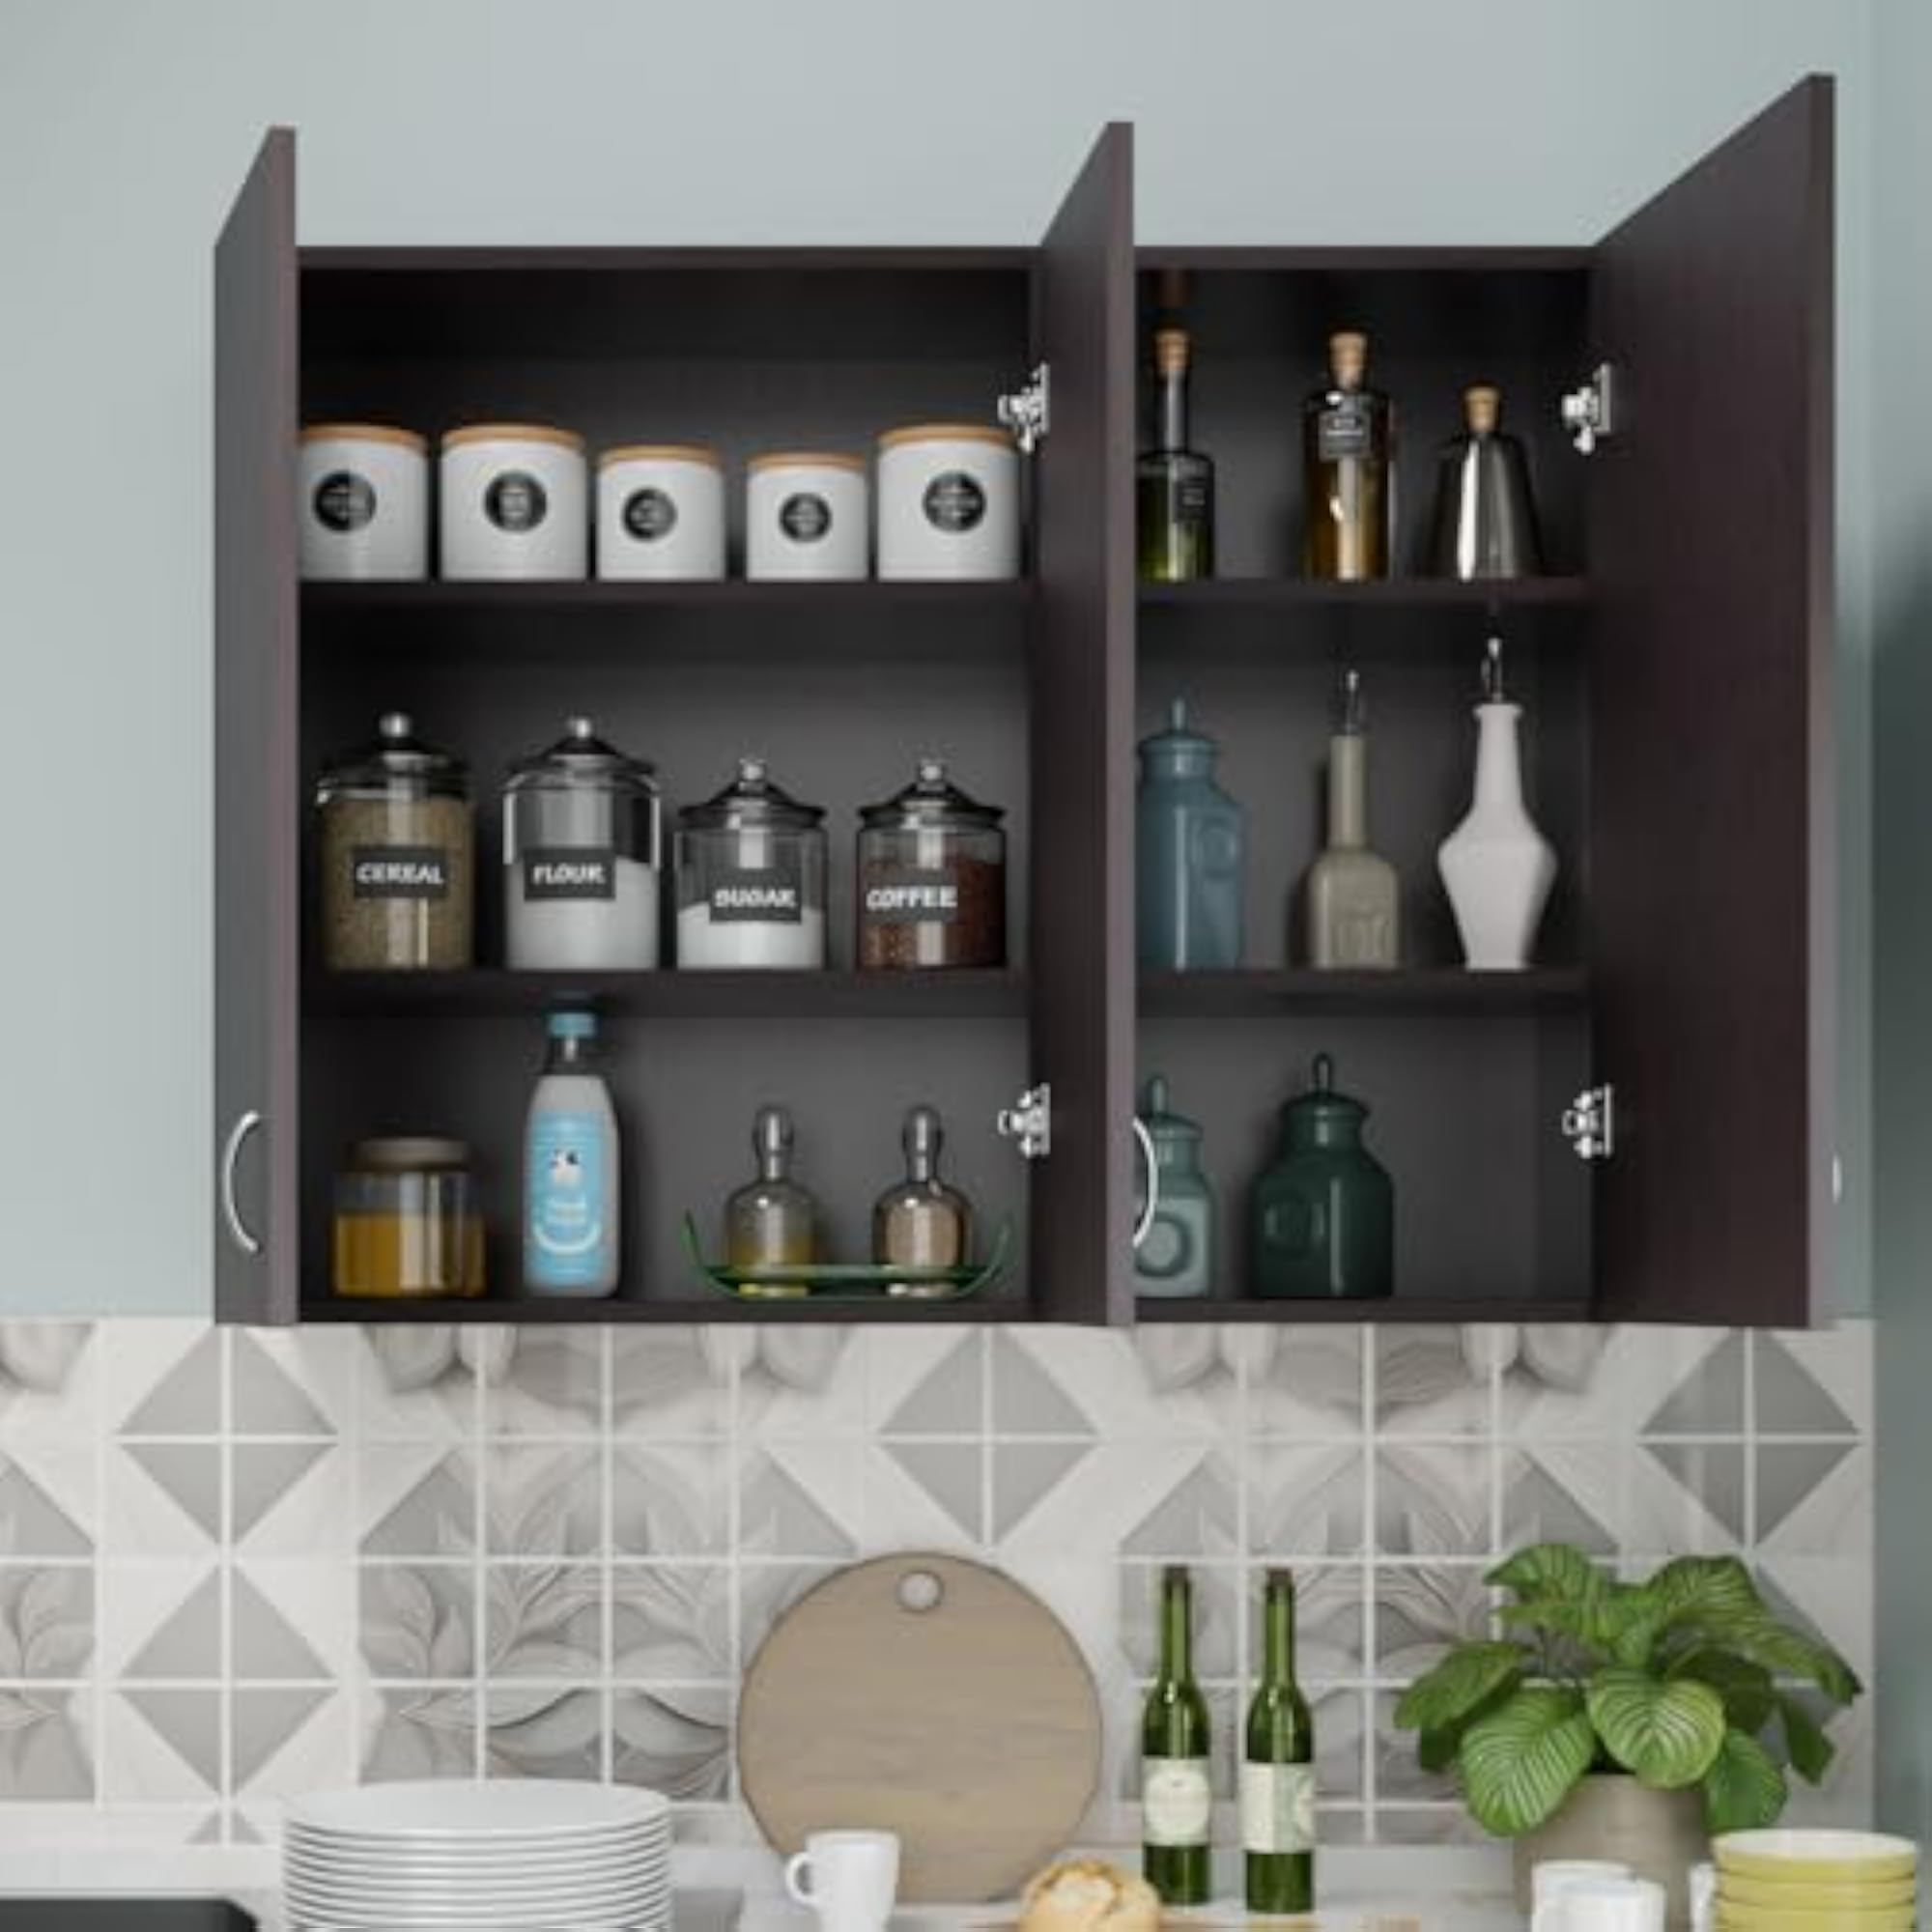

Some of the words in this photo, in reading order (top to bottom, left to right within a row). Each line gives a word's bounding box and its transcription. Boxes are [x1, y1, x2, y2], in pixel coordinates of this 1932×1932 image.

[355, 862, 443, 885] CEREAL
[532, 862, 606, 886] FLOUR
[714, 888, 796, 908] SUGAR
[866, 885, 958, 910] COFFEE
